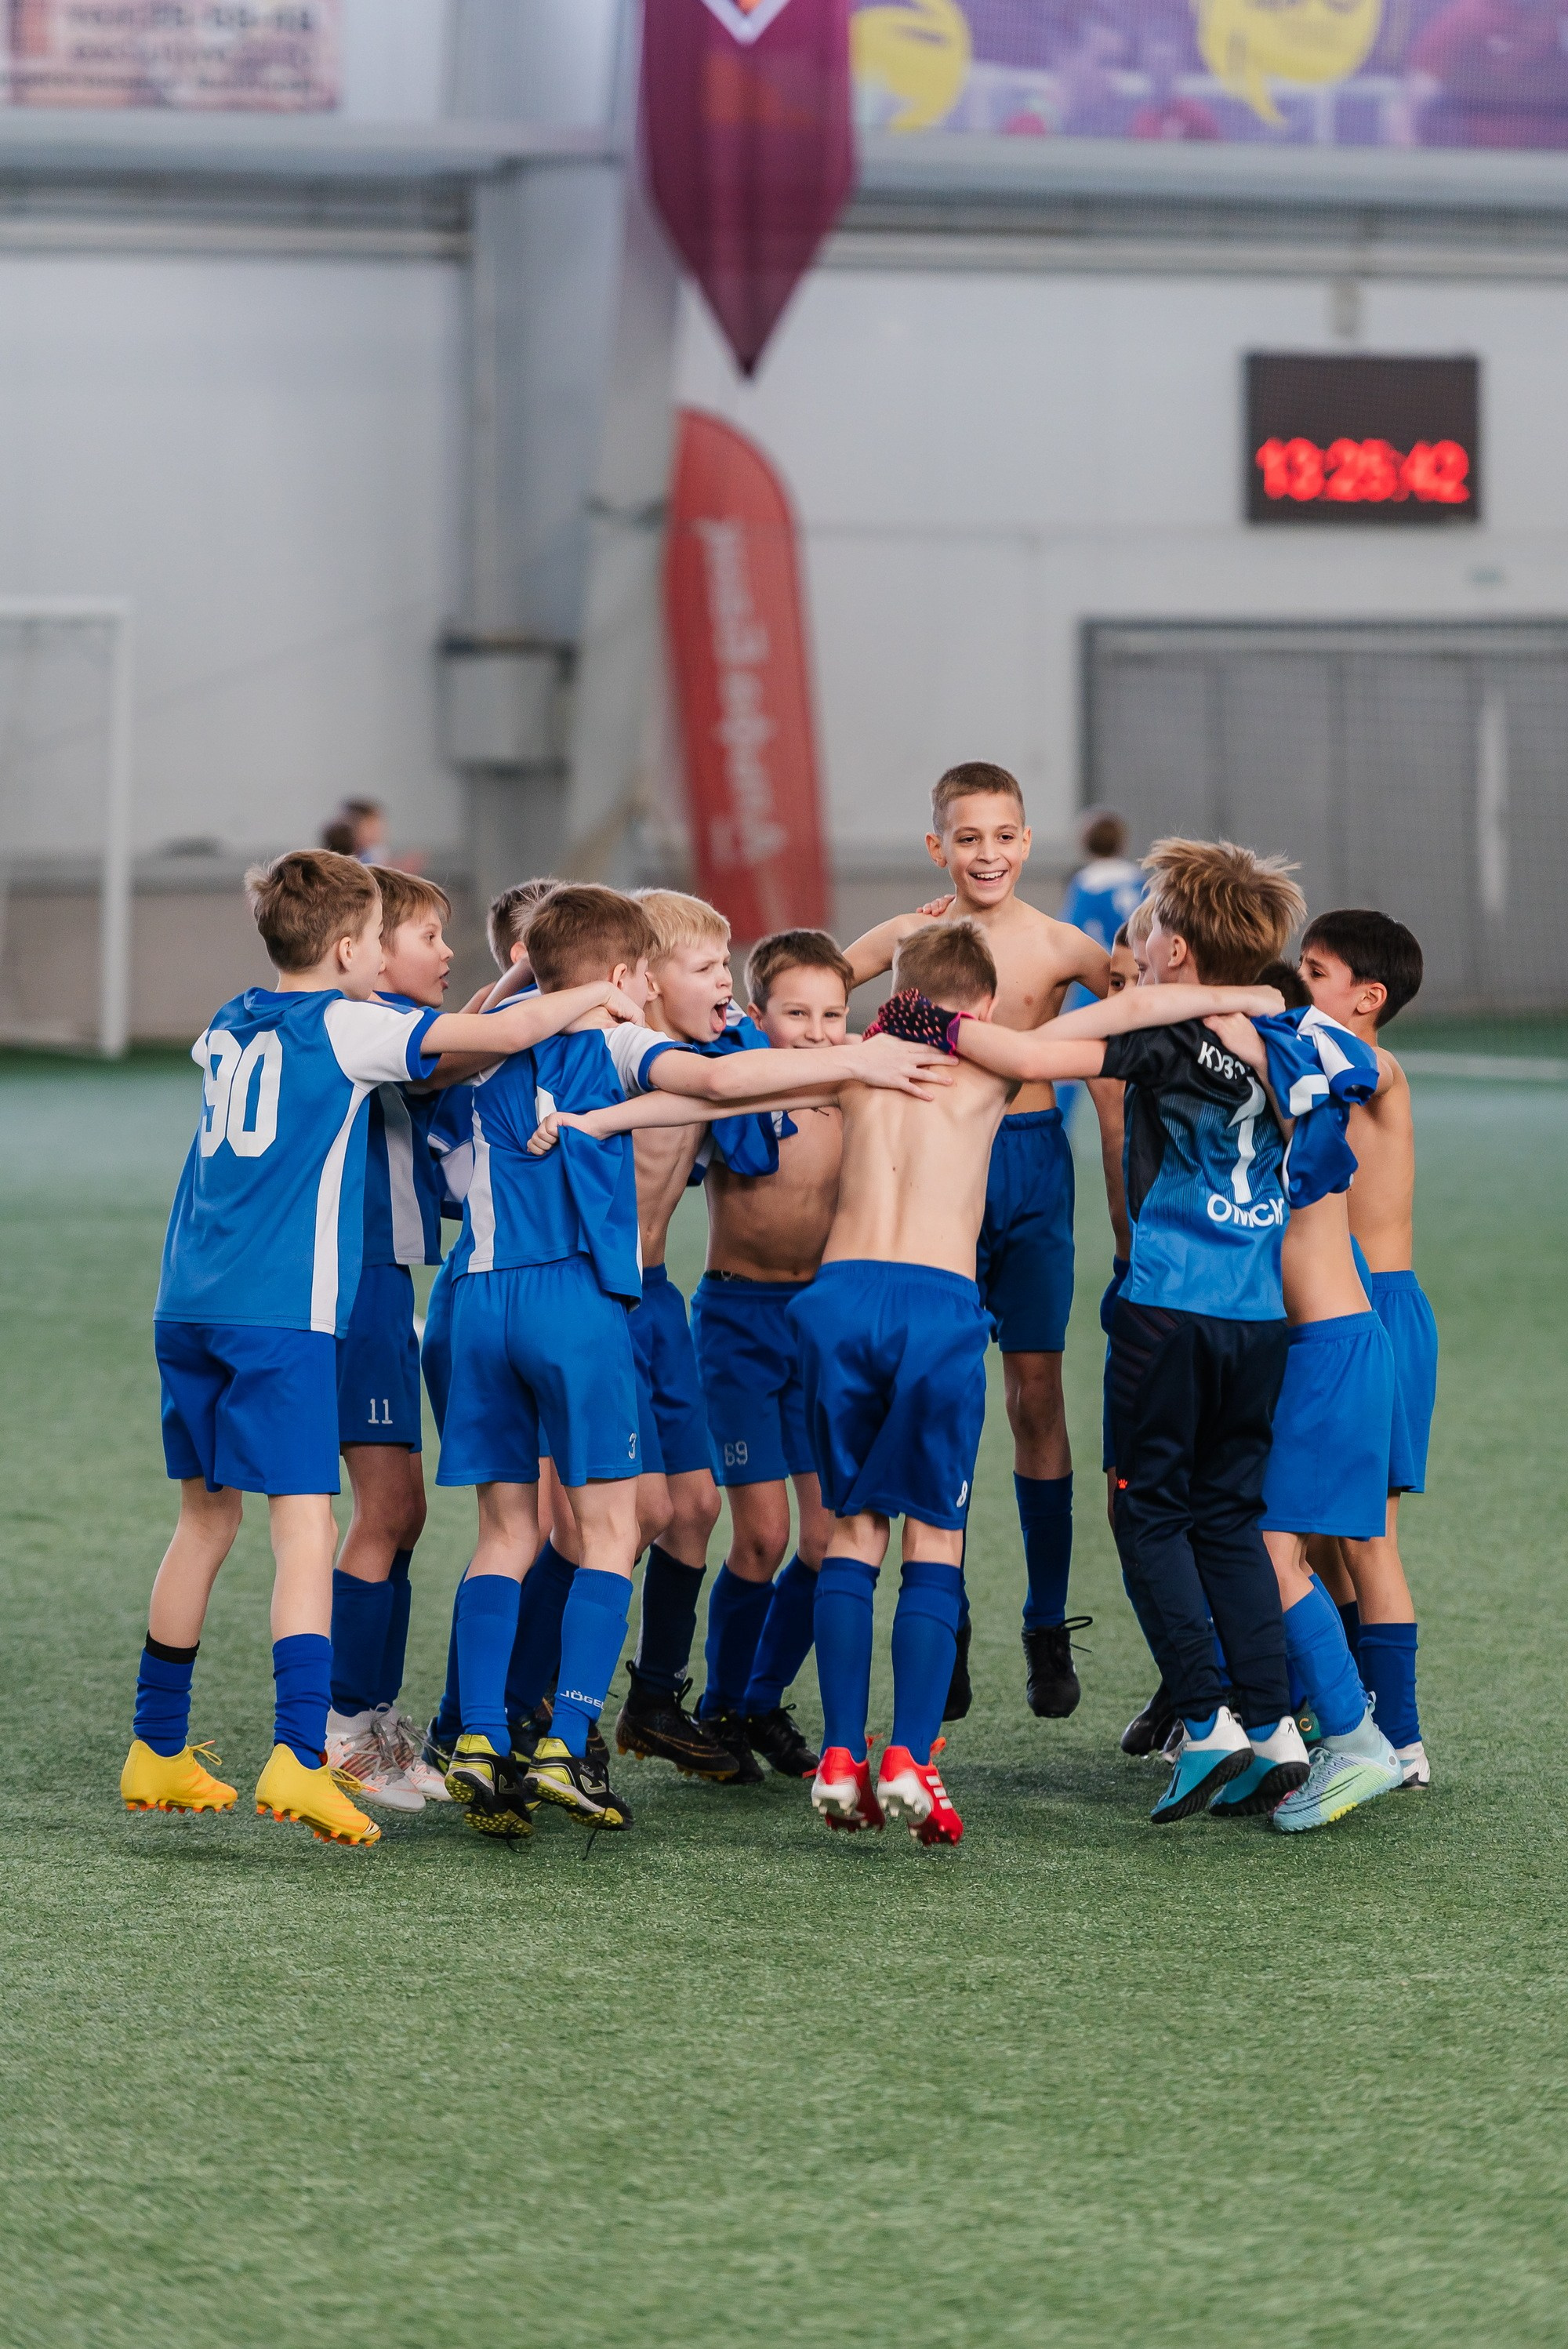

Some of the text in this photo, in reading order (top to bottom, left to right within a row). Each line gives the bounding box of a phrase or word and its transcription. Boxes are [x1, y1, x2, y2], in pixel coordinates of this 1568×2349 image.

[201, 1029, 283, 1158] 90
[1226, 1076, 1266, 1204] 1
[1207, 1193, 1284, 1228] ОМСК
[368, 1398, 393, 1424] 11
[628, 1432, 637, 1459] 3
[724, 1440, 748, 1466] 69
[956, 1479, 968, 1508] 8
